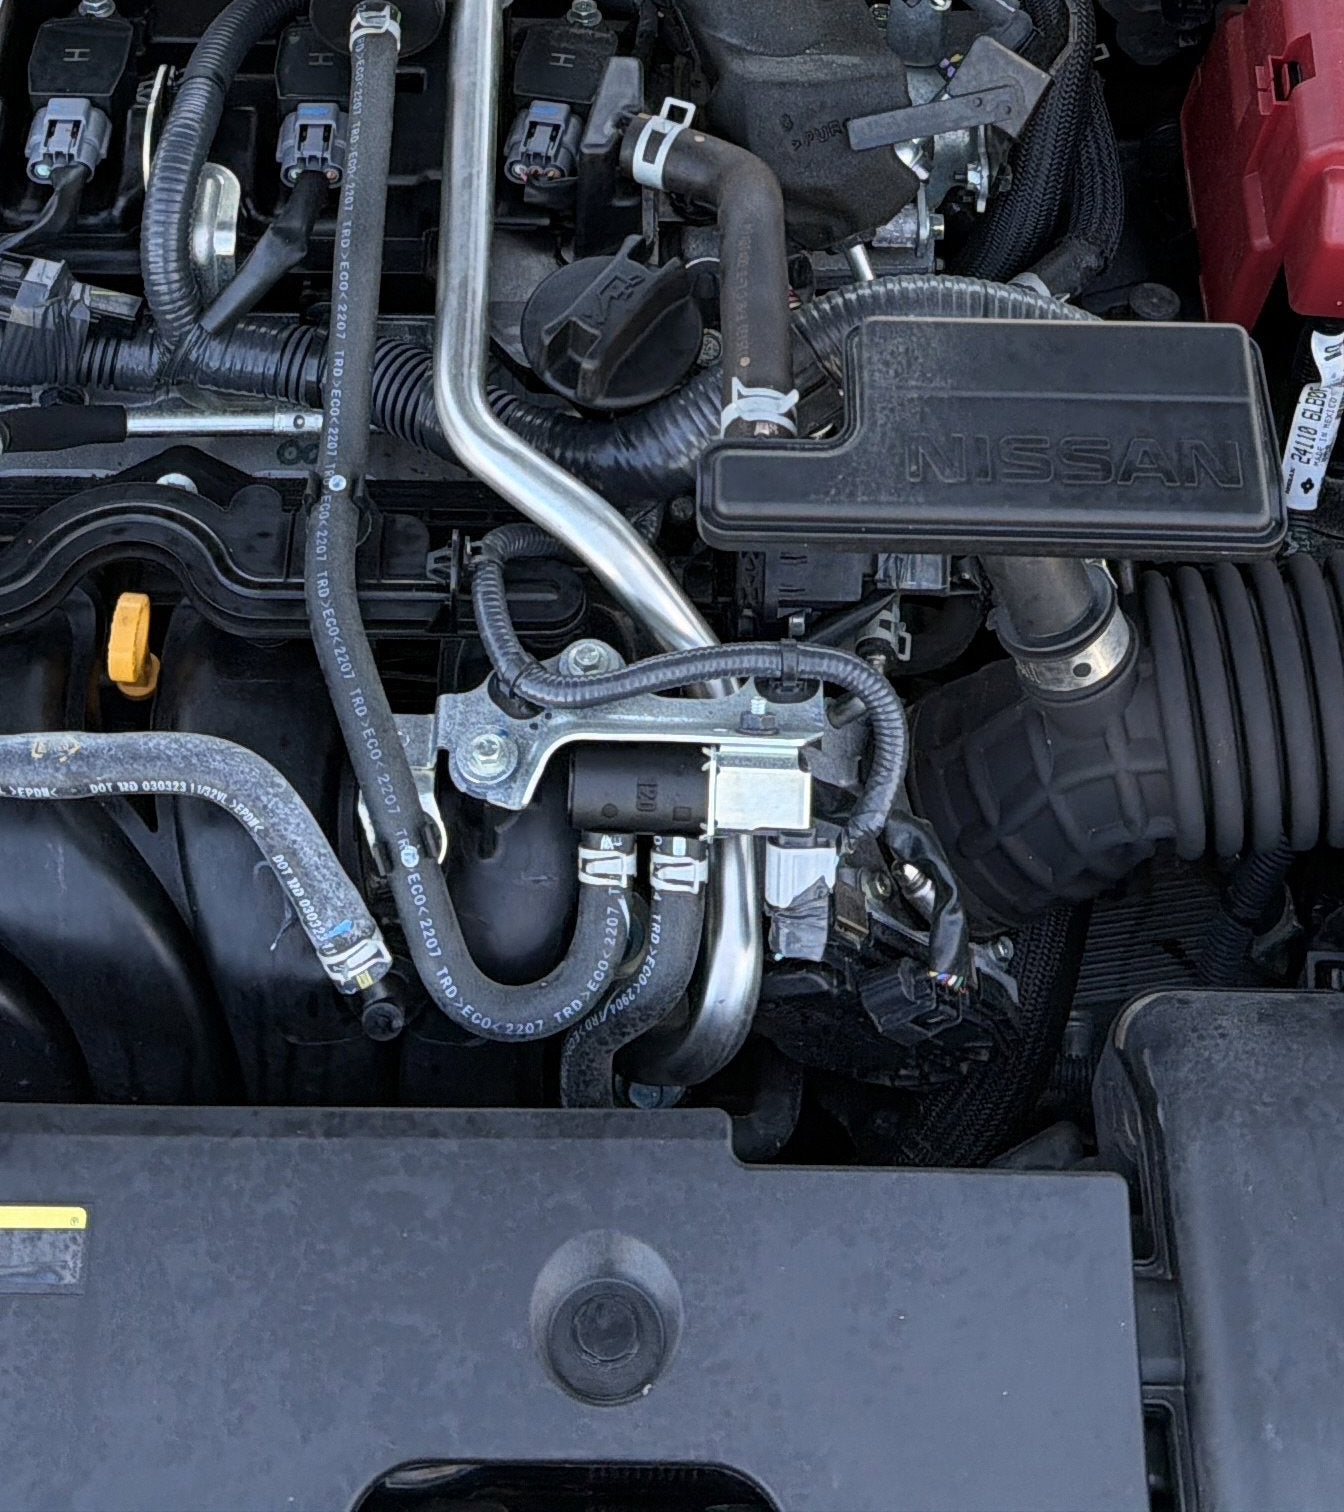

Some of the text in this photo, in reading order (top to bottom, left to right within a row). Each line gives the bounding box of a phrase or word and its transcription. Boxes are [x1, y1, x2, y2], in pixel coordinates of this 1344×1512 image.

[1323, 397, 1337, 429] MEXICO
[905, 433, 1244, 487] NISSAN
[1290, 425, 1319, 466] 24110
[142, 780, 187, 793] 030323
